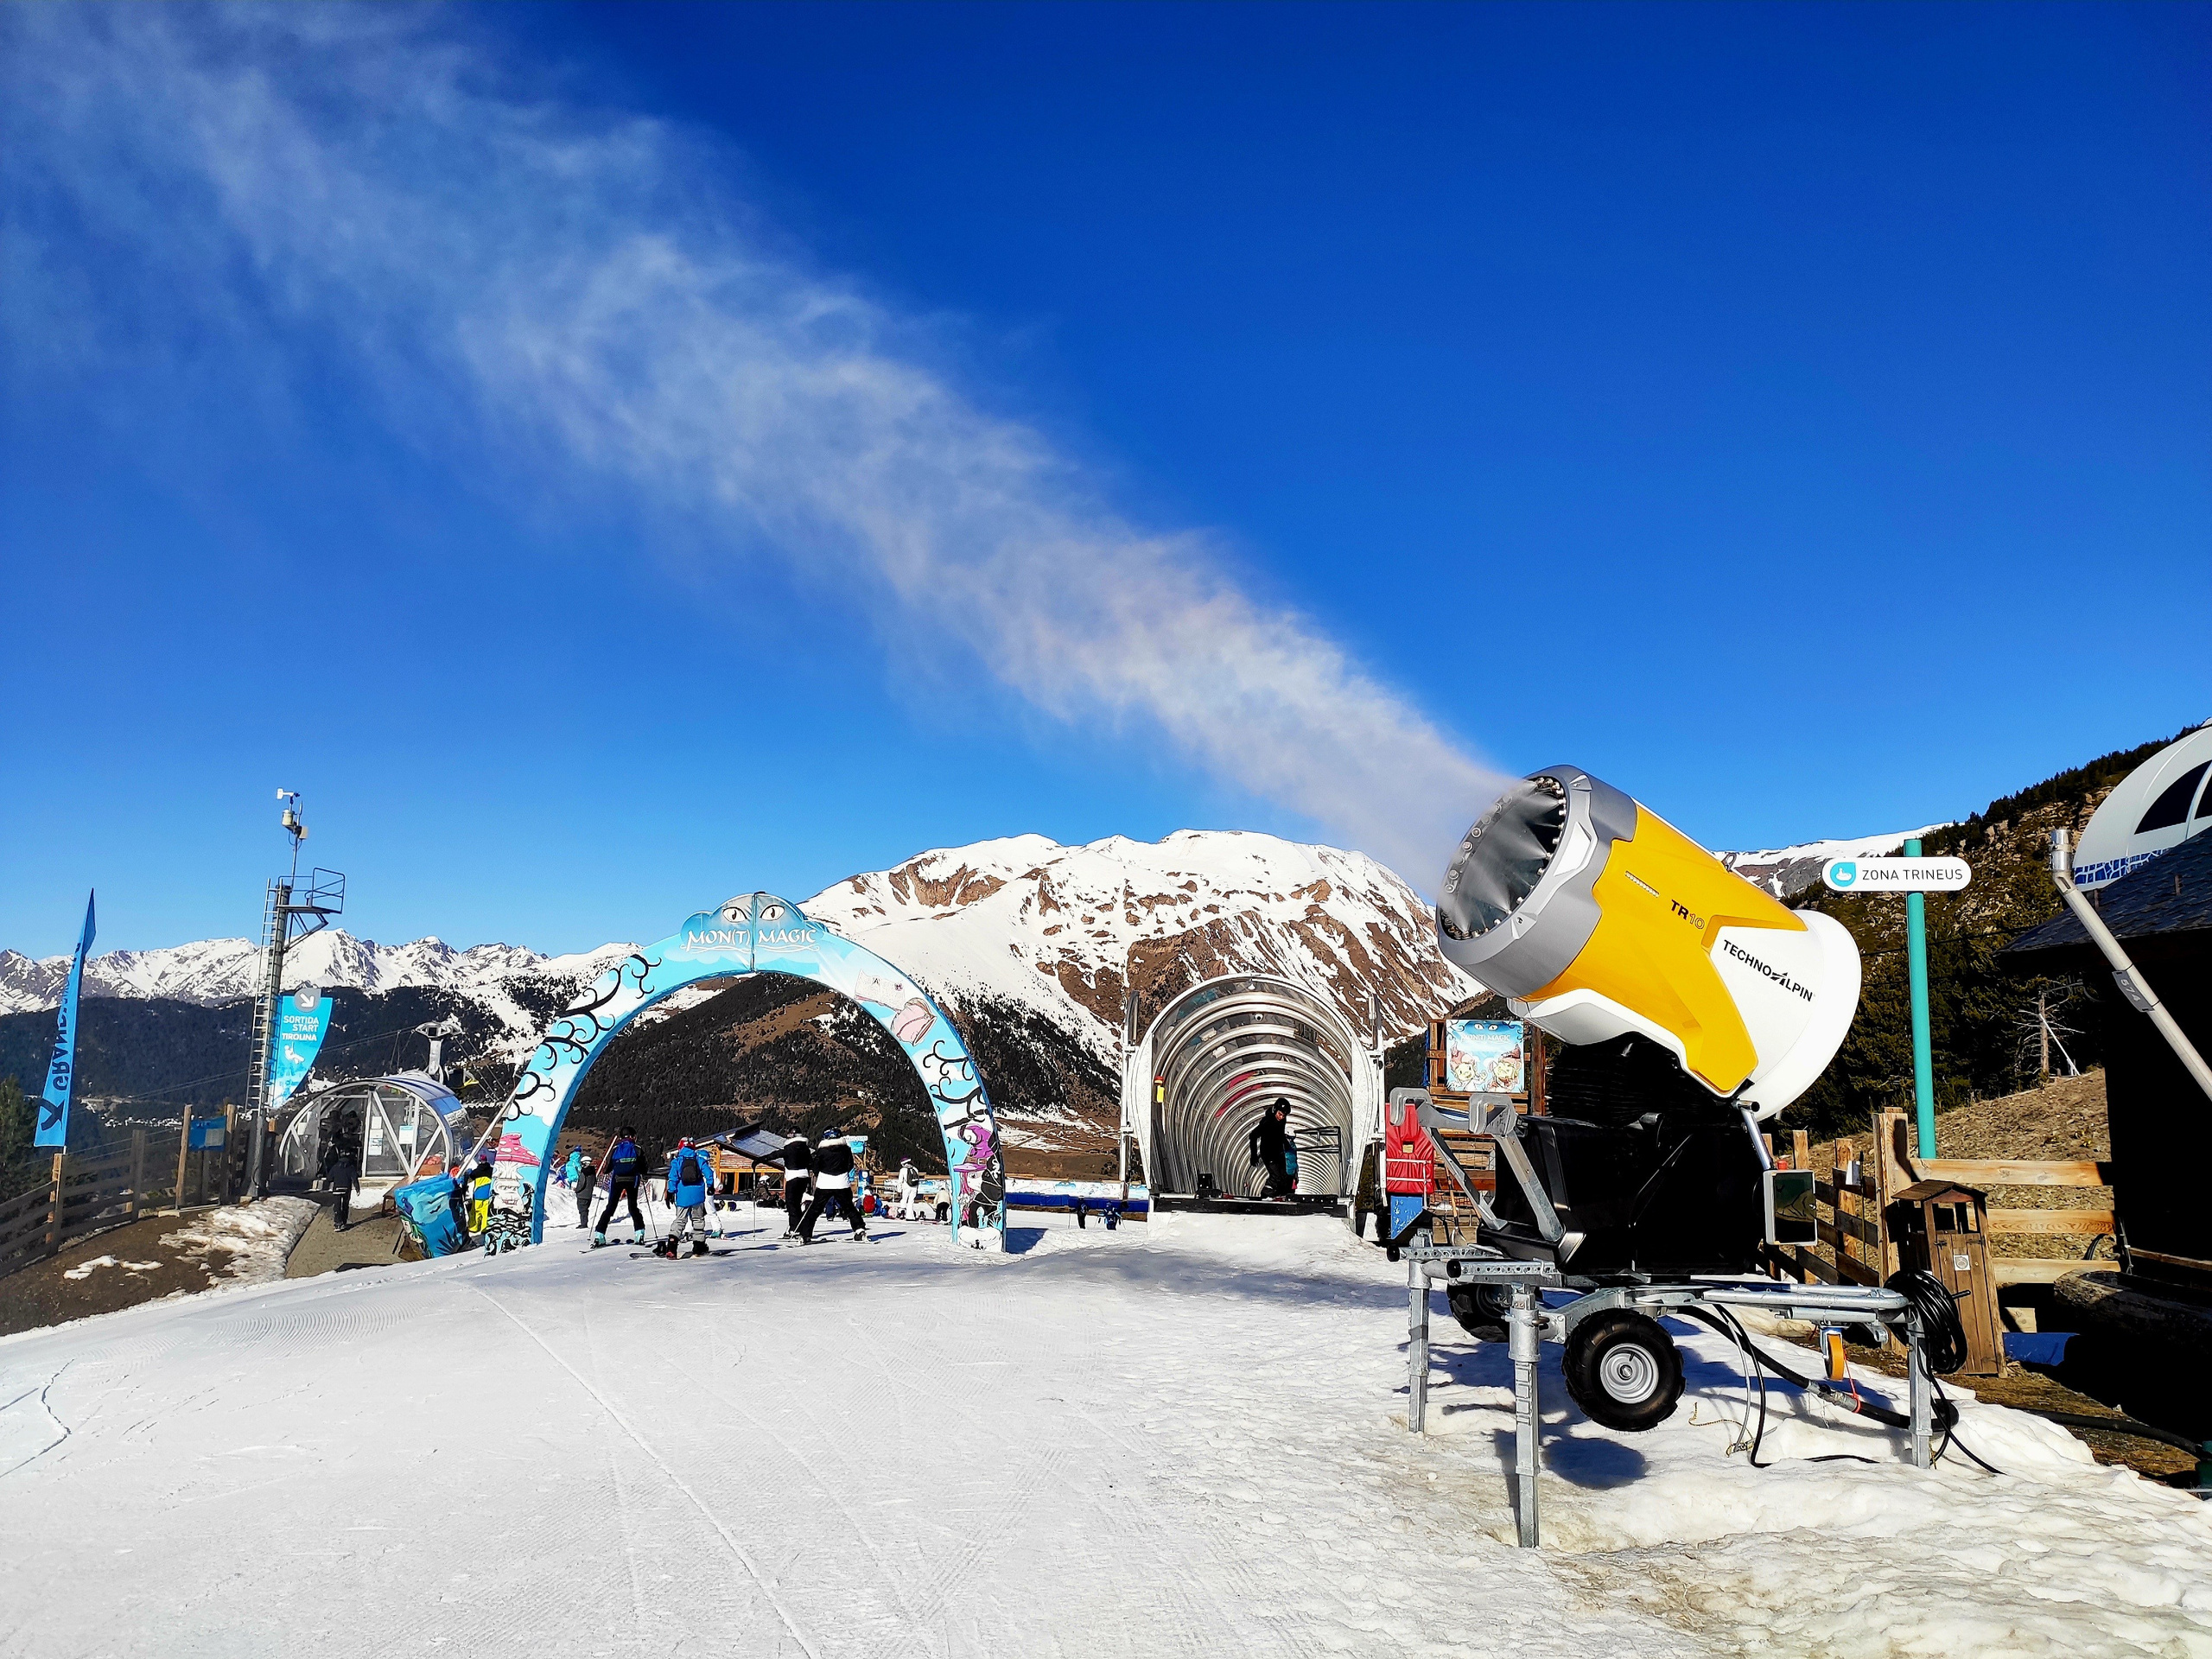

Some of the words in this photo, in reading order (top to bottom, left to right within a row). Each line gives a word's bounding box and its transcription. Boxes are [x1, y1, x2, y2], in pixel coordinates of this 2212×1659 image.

[1862, 869, 1900, 880] ZONA
[1903, 869, 1963, 880] TRINEUS
[1670, 899, 1705, 930] TR10
[685, 929, 751, 953] MON(T)
[758, 929, 817, 944] MAGIC
[1724, 939, 1813, 1002] TECHNOALPIN
[2120, 978, 2141, 1001] 574
[283, 1015, 319, 1024] SORTIDA
[282, 1033, 317, 1041] TIROLINA
[292, 1024, 319, 1033] START
